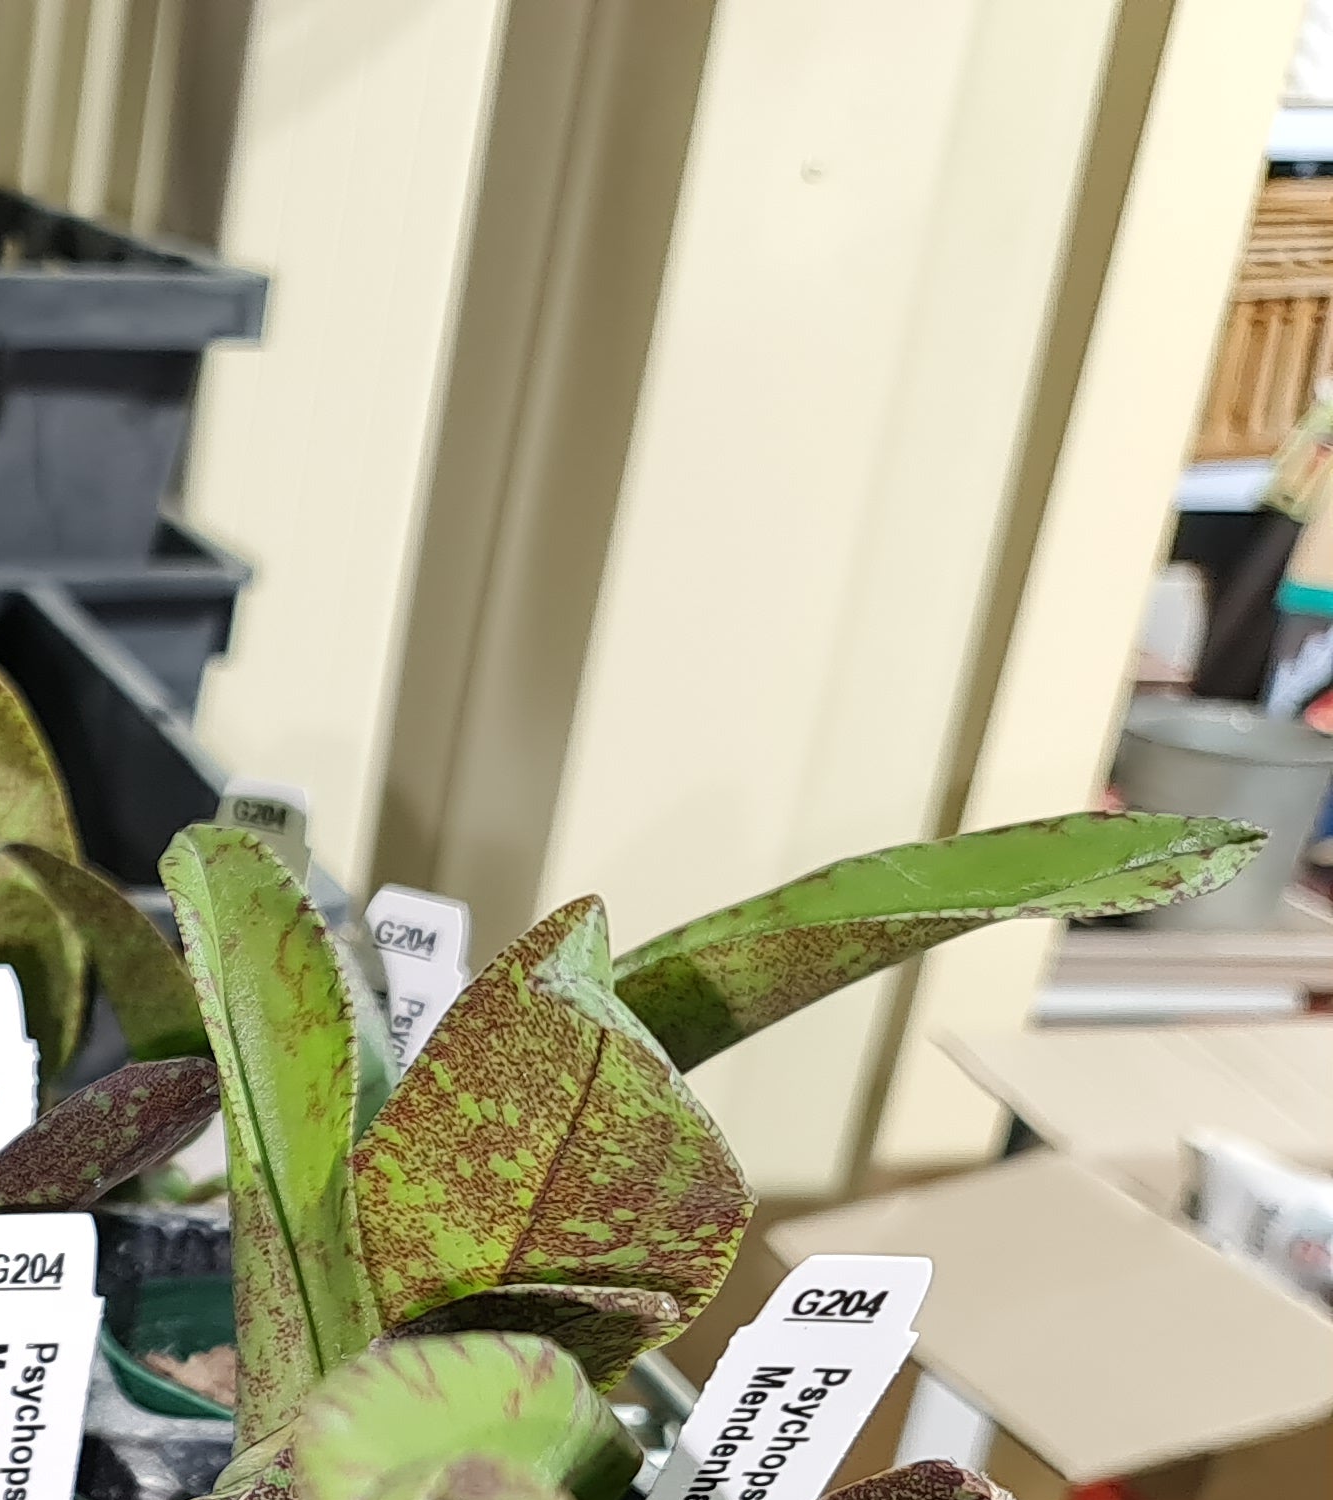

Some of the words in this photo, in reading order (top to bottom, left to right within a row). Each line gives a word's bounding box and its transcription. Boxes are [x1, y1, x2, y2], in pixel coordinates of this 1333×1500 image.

[233, 800, 287, 829] G204
[375, 920, 437, 956] G204
[792, 1289, 889, 1318] G204
